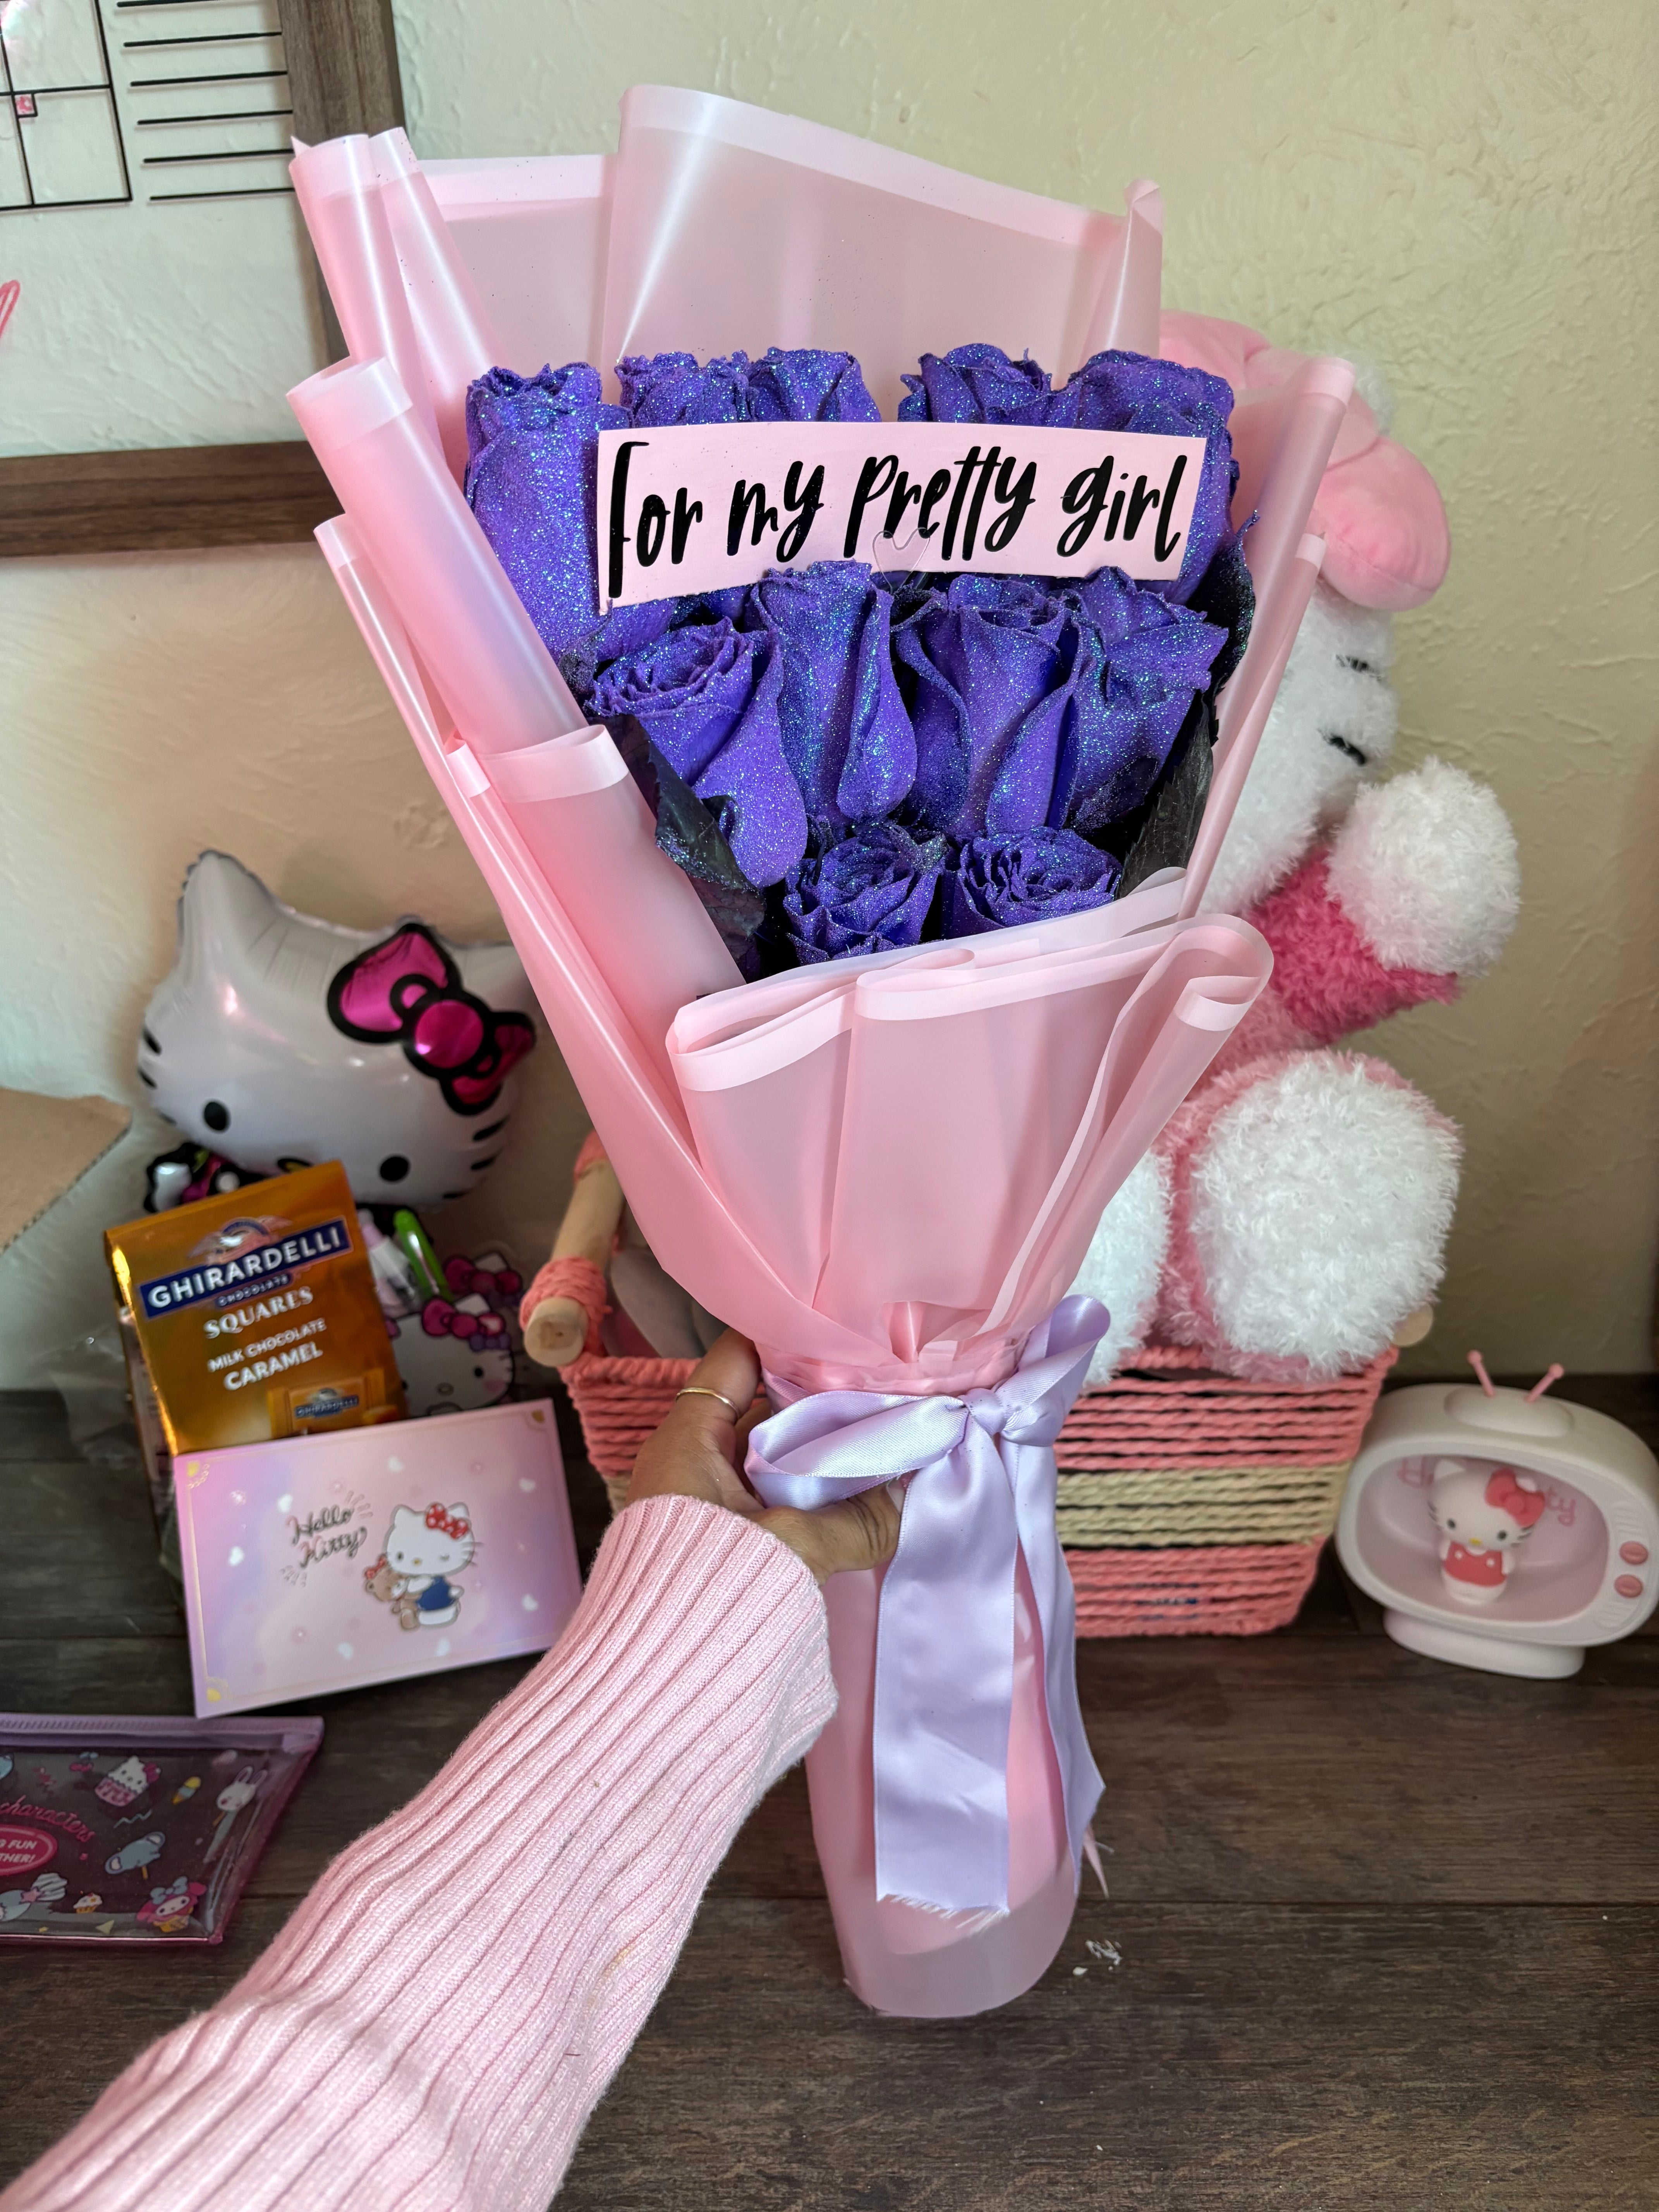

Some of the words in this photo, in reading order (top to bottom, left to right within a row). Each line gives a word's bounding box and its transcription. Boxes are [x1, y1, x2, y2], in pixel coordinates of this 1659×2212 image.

[727, 461, 824, 563] my
[1057, 455, 1187, 562] girl
[148, 1226, 341, 1308] GHIRARDELLI
[218, 1273, 289, 1307] CHOCOLATE
[203, 1286, 313, 1339] SQUARES
[207, 1348, 244, 1373] MILK
[244, 1317, 327, 1358] CHOCOLATE
[223, 1341, 323, 1391] CARAMEL
[286, 1505, 354, 1546] Hello
[298, 1526, 368, 1569] Kitty
[8, 1839, 38, 1850] FUN
